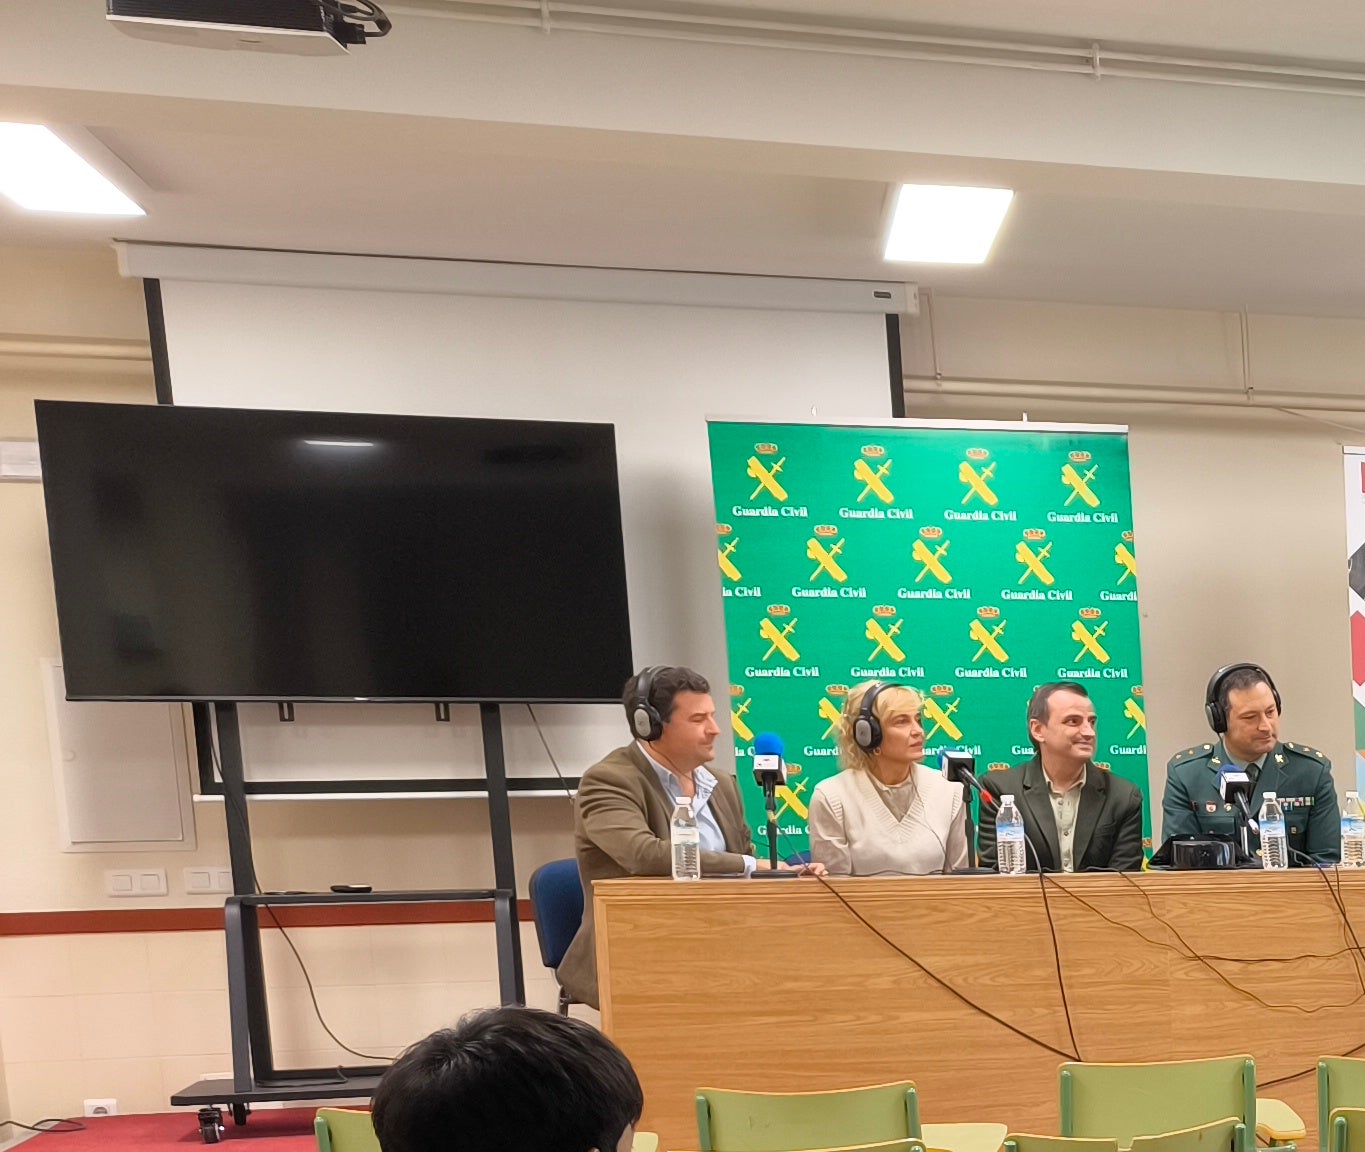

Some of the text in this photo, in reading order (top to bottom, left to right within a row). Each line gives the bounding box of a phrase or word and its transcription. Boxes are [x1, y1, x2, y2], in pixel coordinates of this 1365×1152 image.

[732, 505, 809, 518] Guardia Civil
[839, 507, 915, 520] Guardia Civil
[943, 509, 1018, 522] Guardia Civil
[1047, 511, 1119, 523] Guardia Civil
[734, 586, 762, 597] Civil
[791, 586, 867, 598] Guardia Civil
[897, 587, 971, 600] Guardia Civil
[1001, 589, 1074, 601] Guardia Civil
[744, 666, 820, 678] Guardia Civil
[850, 666, 925, 678] Guardia Civil
[954, 666, 1028, 679] Guardia Civil
[1057, 667, 1129, 679] Guardia Civil
